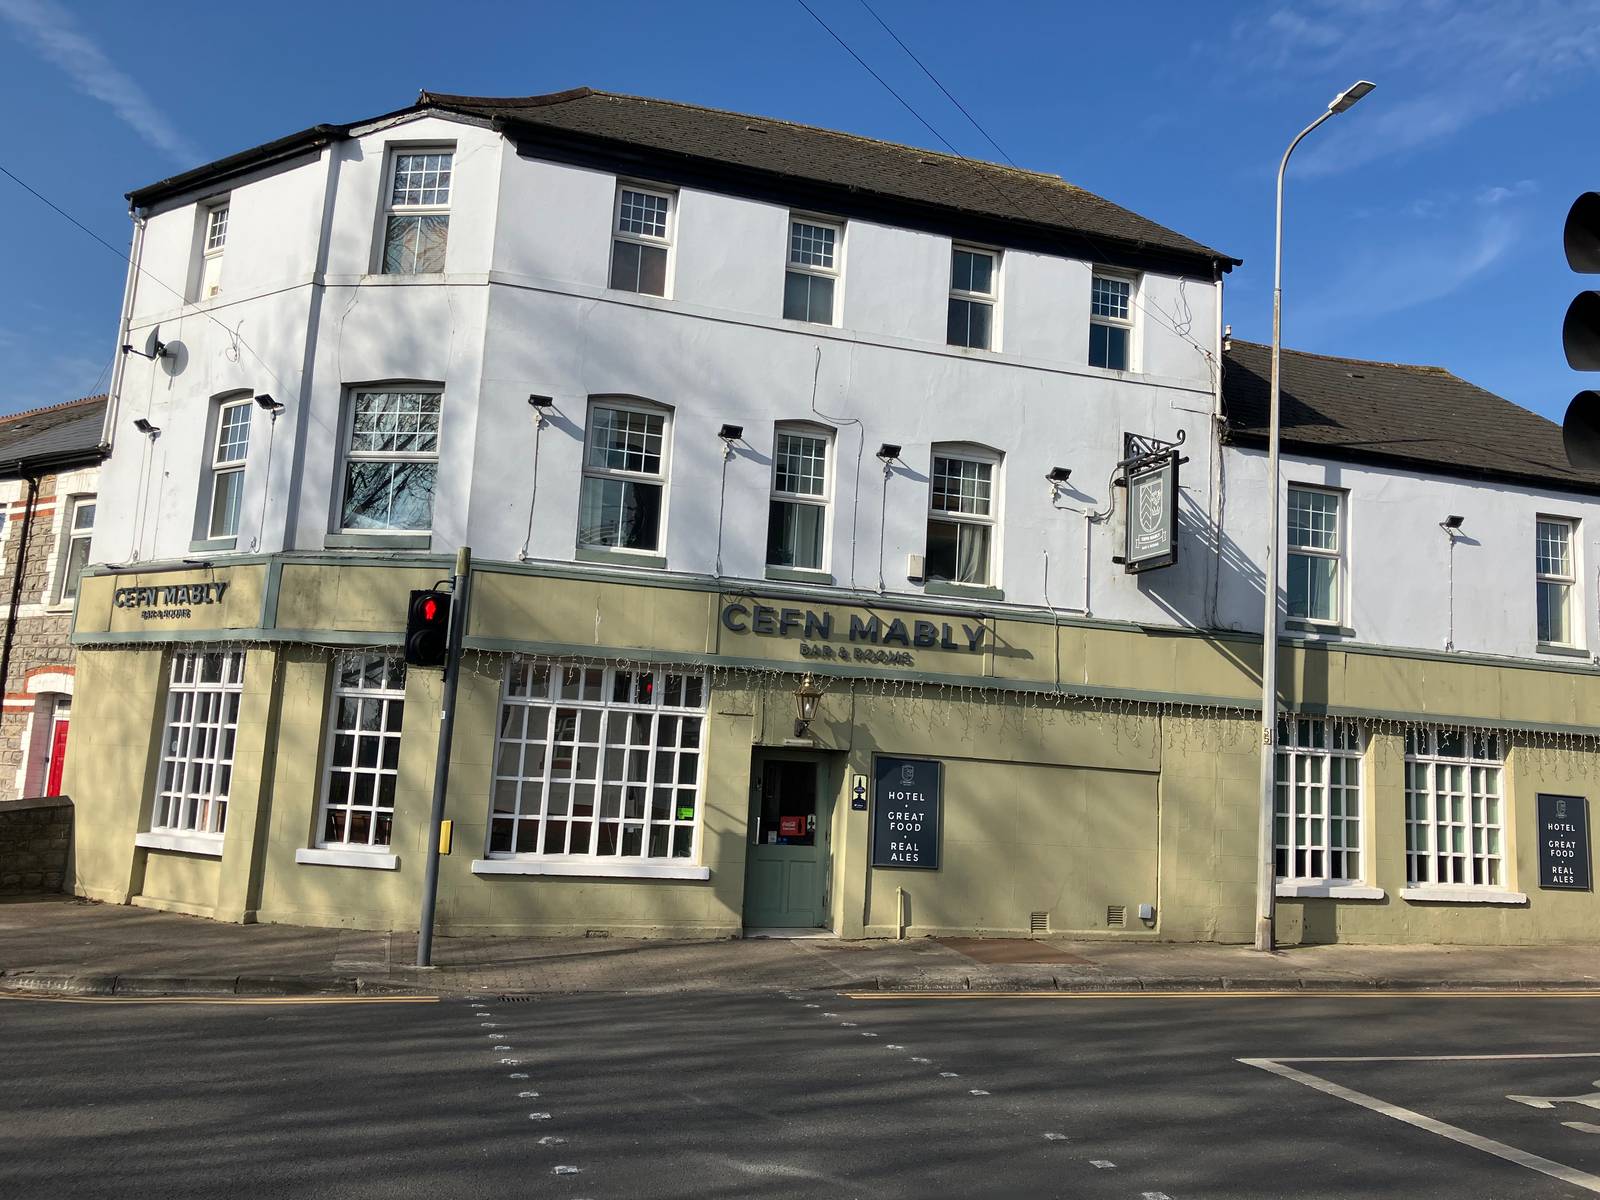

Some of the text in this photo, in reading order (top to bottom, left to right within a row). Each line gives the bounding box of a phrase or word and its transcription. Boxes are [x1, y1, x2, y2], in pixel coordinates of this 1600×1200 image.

[114, 582, 228, 608] CEFN MABLY
[721, 603, 985, 652] CEFN MABLY
[800, 643, 914, 667] BAR & ROOMS
[888, 791, 925, 801] HOTEL
[887, 811, 925, 822] GREAT
[890, 822, 921, 832] FOOD
[1547, 823, 1576, 832] HOTEL
[890, 842, 920, 851] REAL
[1548, 840, 1576, 849] GREAT
[890, 852, 919, 862] ALES
[1550, 849, 1575, 858] FOOD
[1552, 866, 1574, 875] REAL
[1552, 875, 1574, 884] ALES
